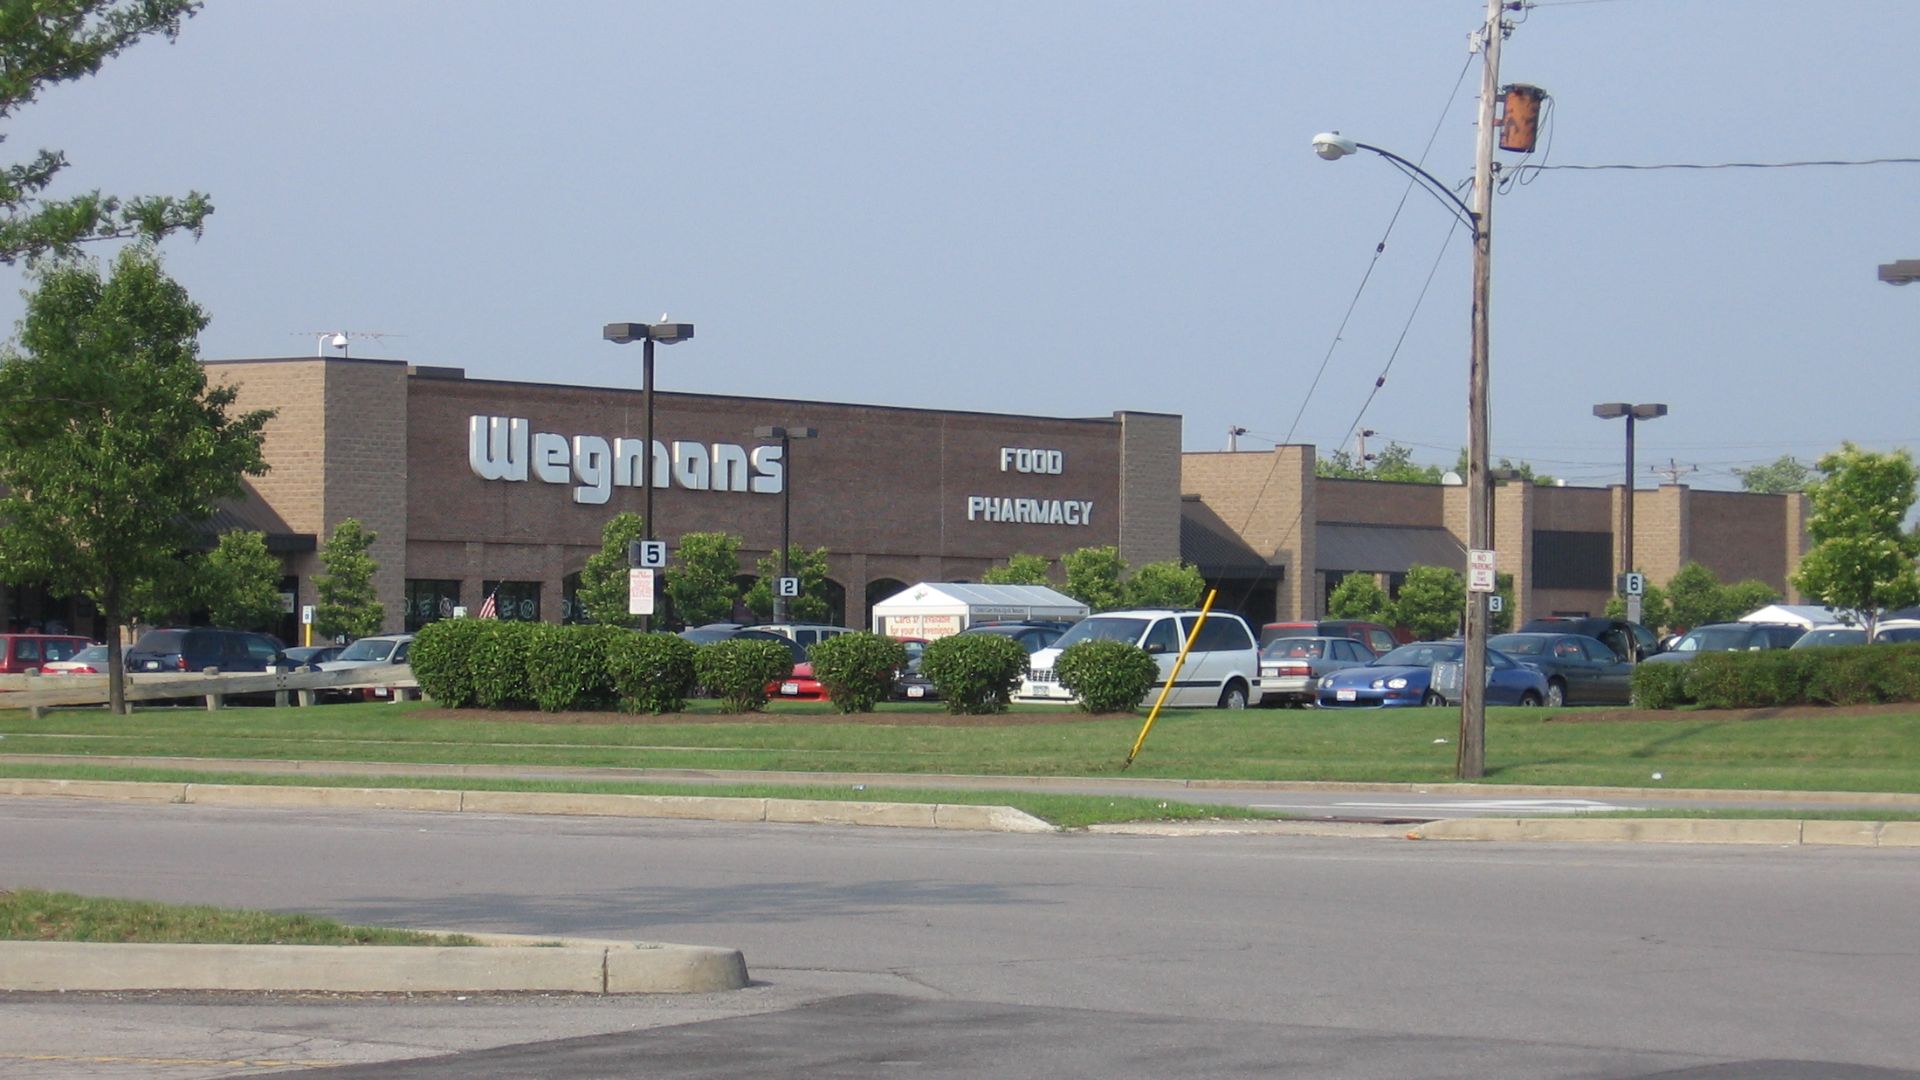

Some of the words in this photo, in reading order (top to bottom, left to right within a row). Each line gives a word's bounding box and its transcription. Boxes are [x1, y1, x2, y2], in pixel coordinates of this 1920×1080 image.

[469, 414, 783, 504] Wegmans
[1000, 447, 1064, 475] FOOD
[967, 496, 1093, 526] PHARMACY
[647, 544, 660, 564] 5
[1477, 554, 1487, 562] NO
[784, 580, 794, 594] 2
[1630, 576, 1639, 591] 6
[1491, 598, 1499, 610] 3
